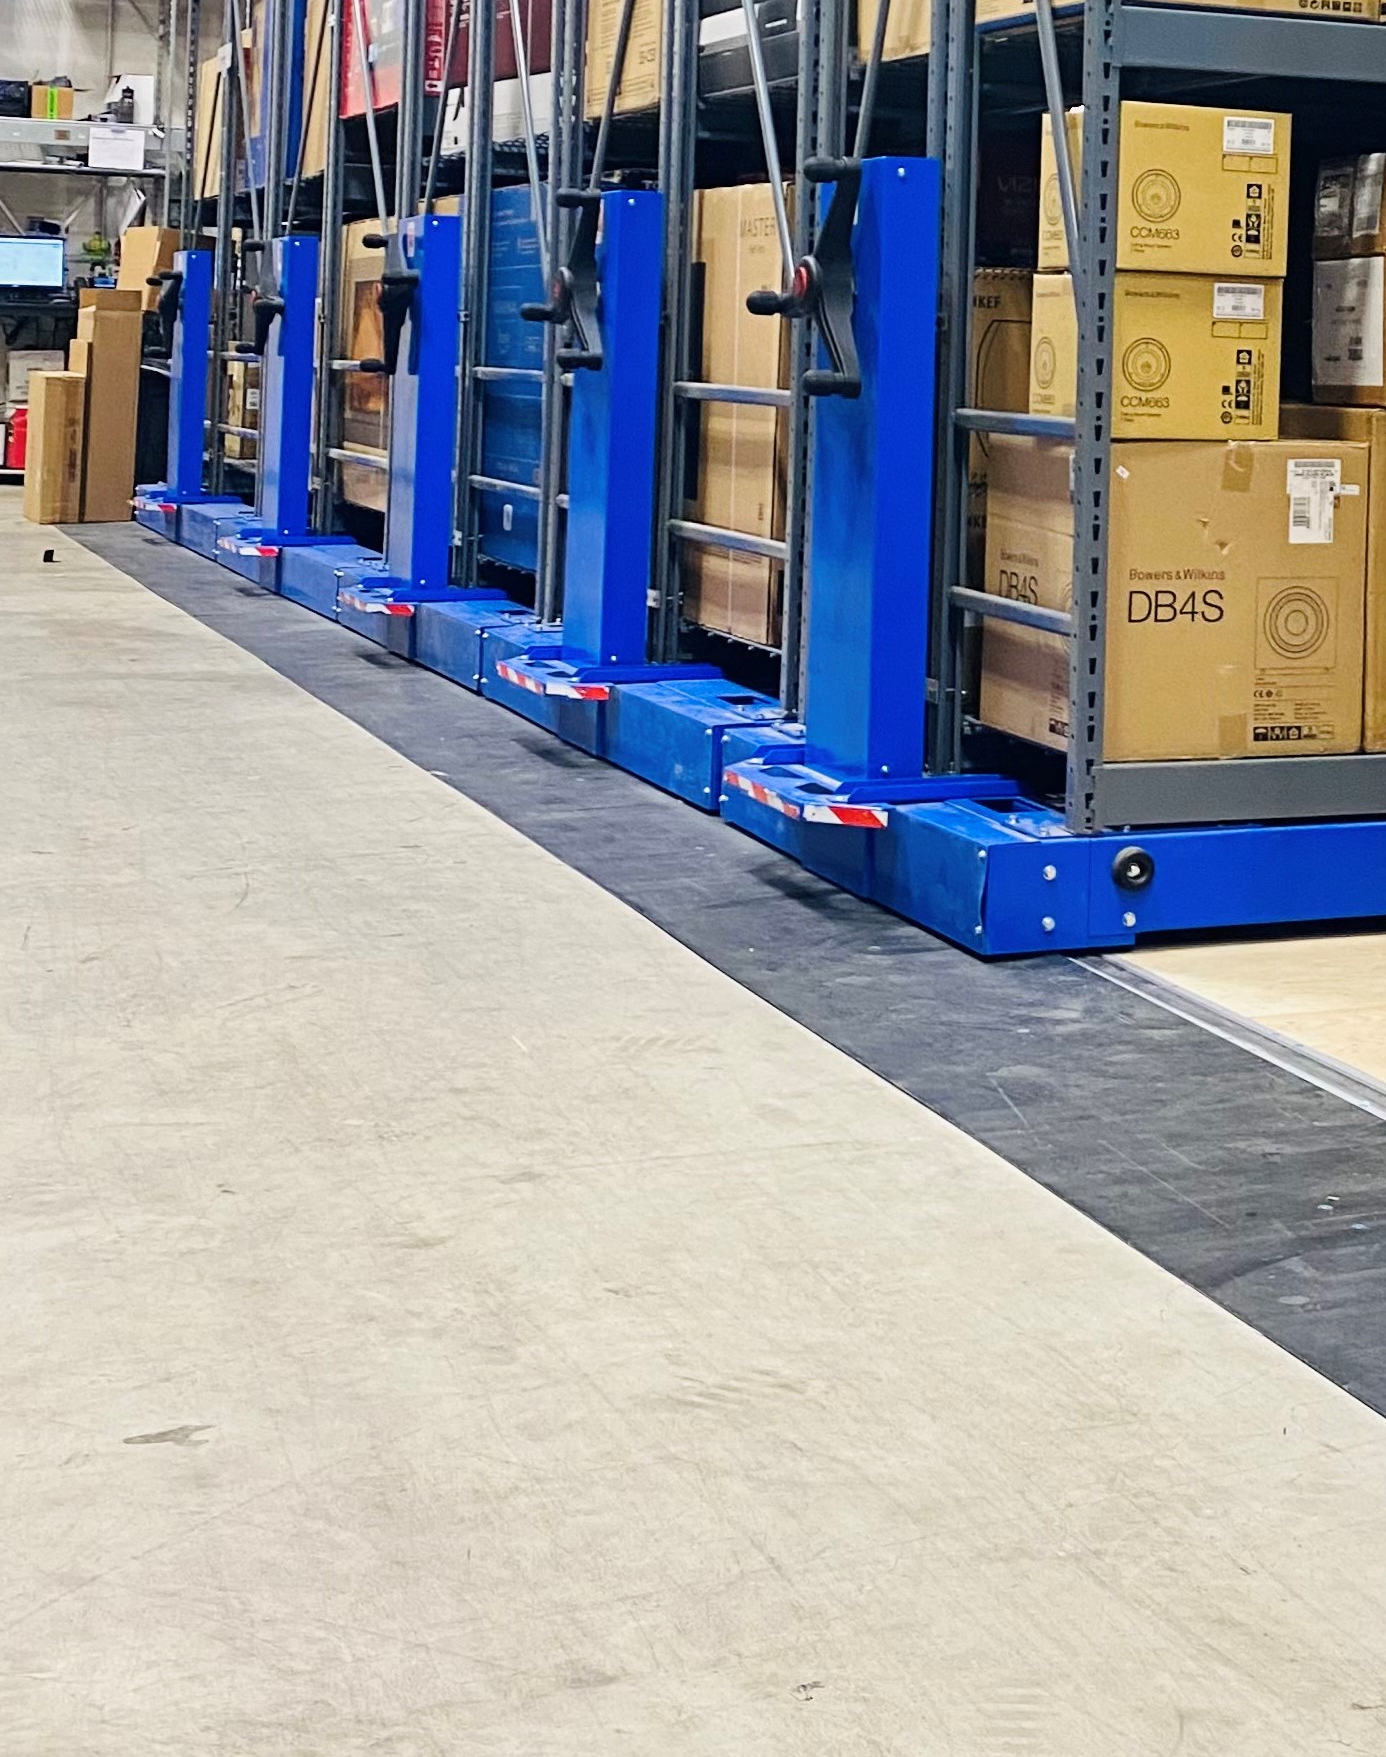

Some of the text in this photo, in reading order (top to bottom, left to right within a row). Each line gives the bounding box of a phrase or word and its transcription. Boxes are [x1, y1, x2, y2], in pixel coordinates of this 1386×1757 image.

[1130, 225, 1180, 241] CCM663
[978, 296, 1001, 309] KEF
[1120, 395, 1170, 409] CCM663
[1129, 568, 1173, 581] Bowers
[1182, 568, 1225, 581] Wilkins
[1127, 589, 1225, 623] DB4S
